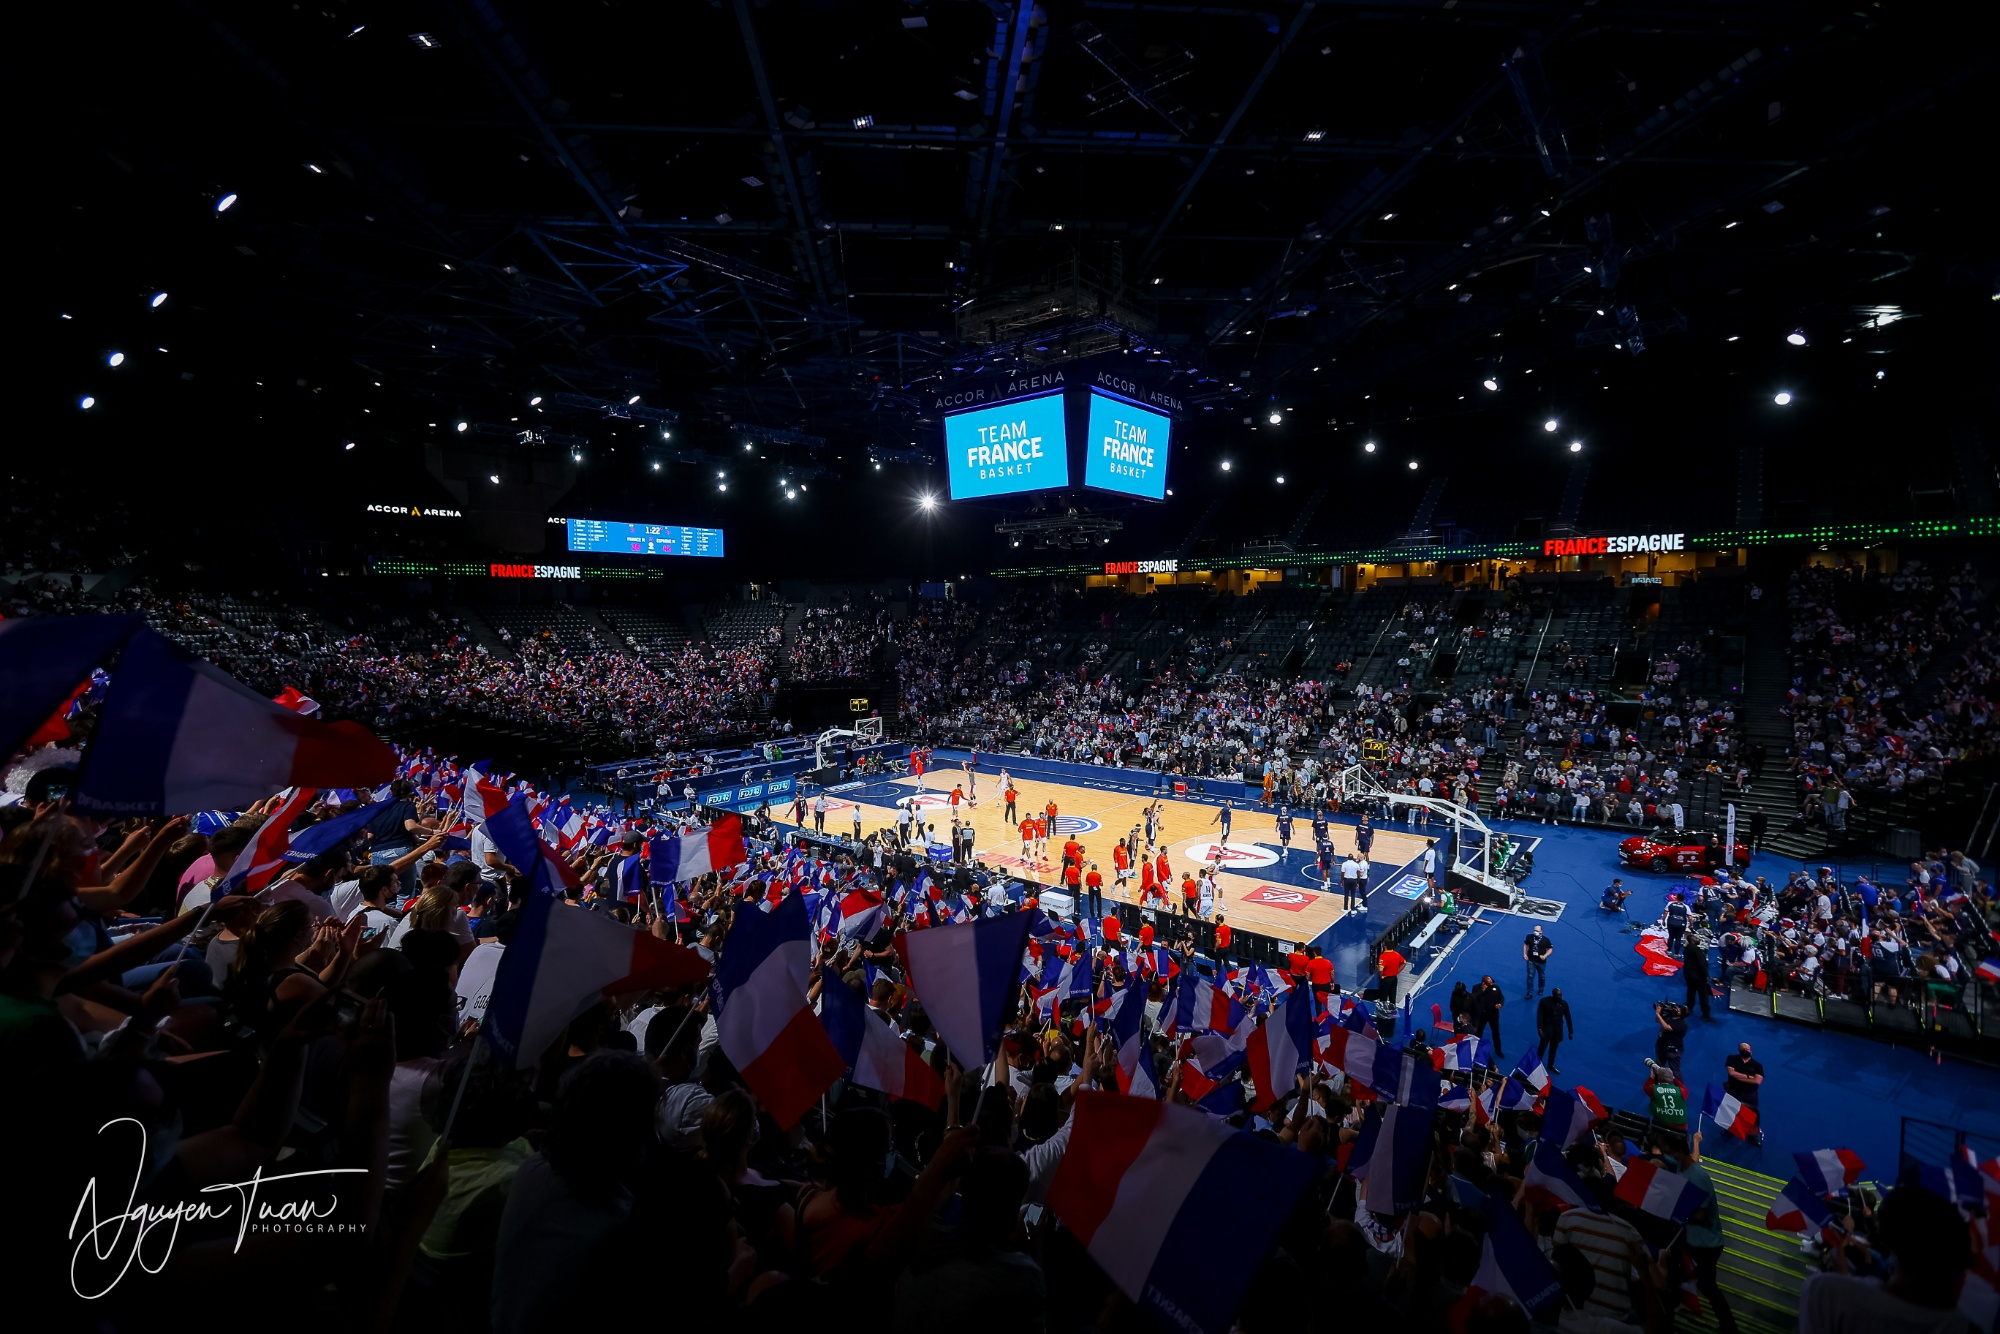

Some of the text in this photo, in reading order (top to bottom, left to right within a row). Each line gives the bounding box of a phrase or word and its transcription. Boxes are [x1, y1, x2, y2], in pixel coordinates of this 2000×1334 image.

[935, 370, 1065, 409] ACCOR ARENA
[1097, 371, 1183, 411] ACCOR ARENA
[977, 419, 1027, 445] TEAM
[1114, 419, 1147, 445] TEAM
[967, 436, 1044, 468] FRANCE
[1103, 436, 1155, 468] FRANCE
[979, 462, 1032, 480] BASKET
[1110, 462, 1147, 480] BASKET
[367, 504, 462, 518] ACCOR ARENA
[1656, 1107, 1684, 1117] PHOTO
[1661, 1094, 1676, 1109] 13
